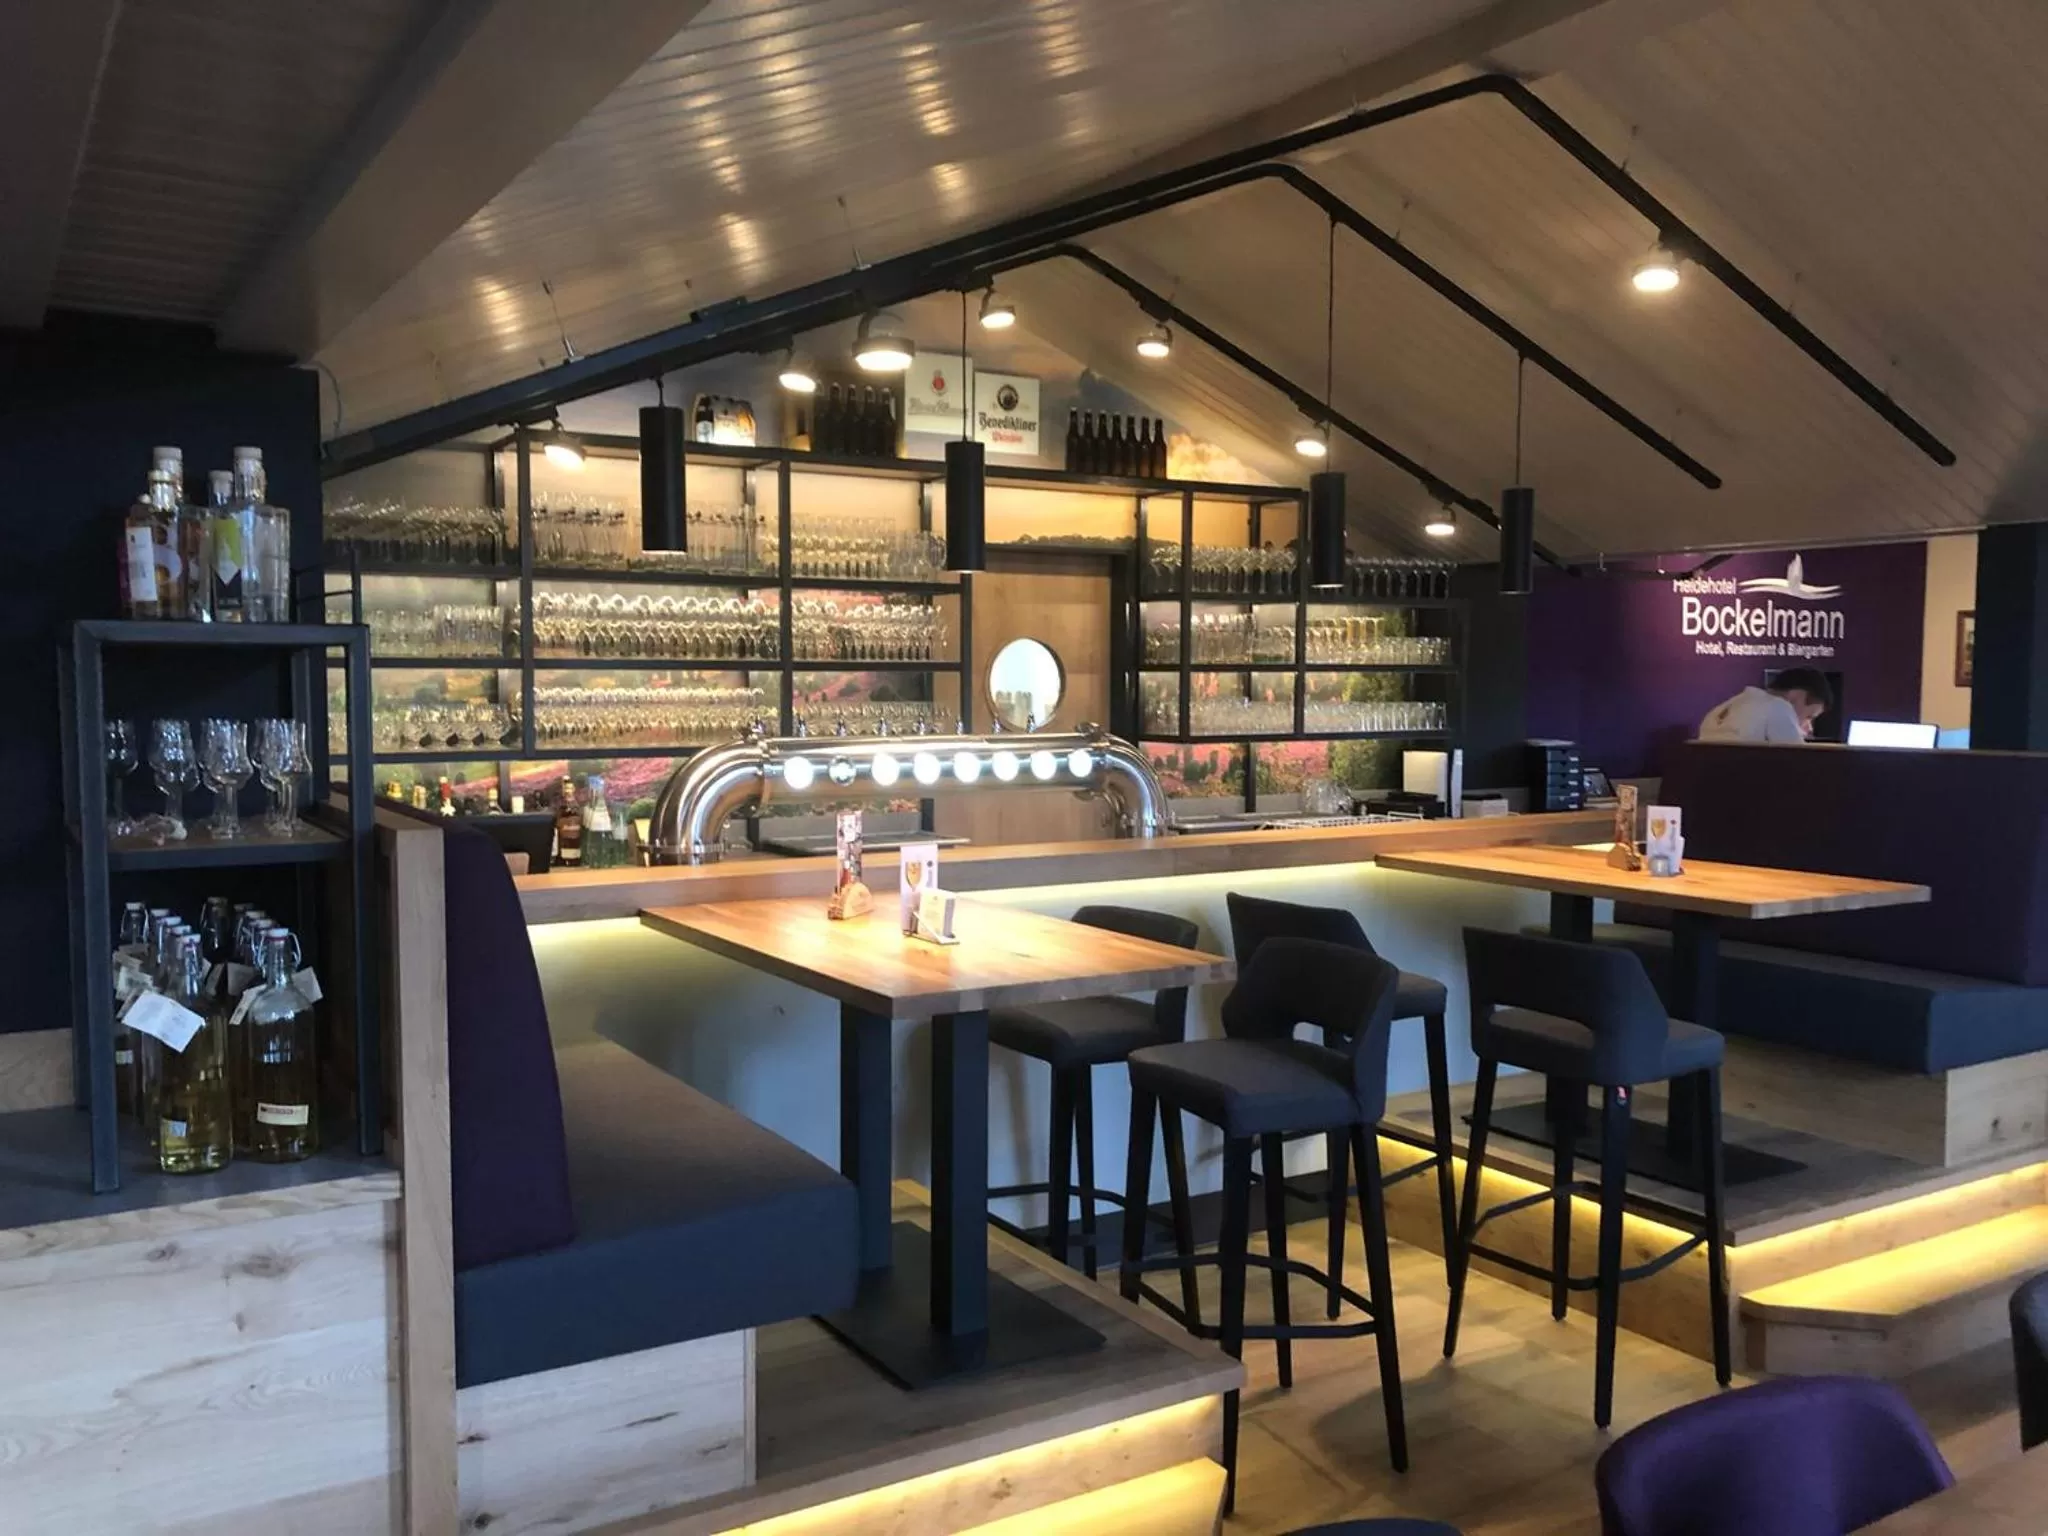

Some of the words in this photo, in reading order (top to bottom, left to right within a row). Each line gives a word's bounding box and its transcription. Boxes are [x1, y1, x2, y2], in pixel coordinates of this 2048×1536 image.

[1682, 596, 1844, 639] Bockelmann
[1696, 641, 1724, 657] Hotel,
[1726, 641, 1776, 656] Restaurant
[1778, 643, 1785, 656] &
[1787, 643, 1834, 659] Biergarten
